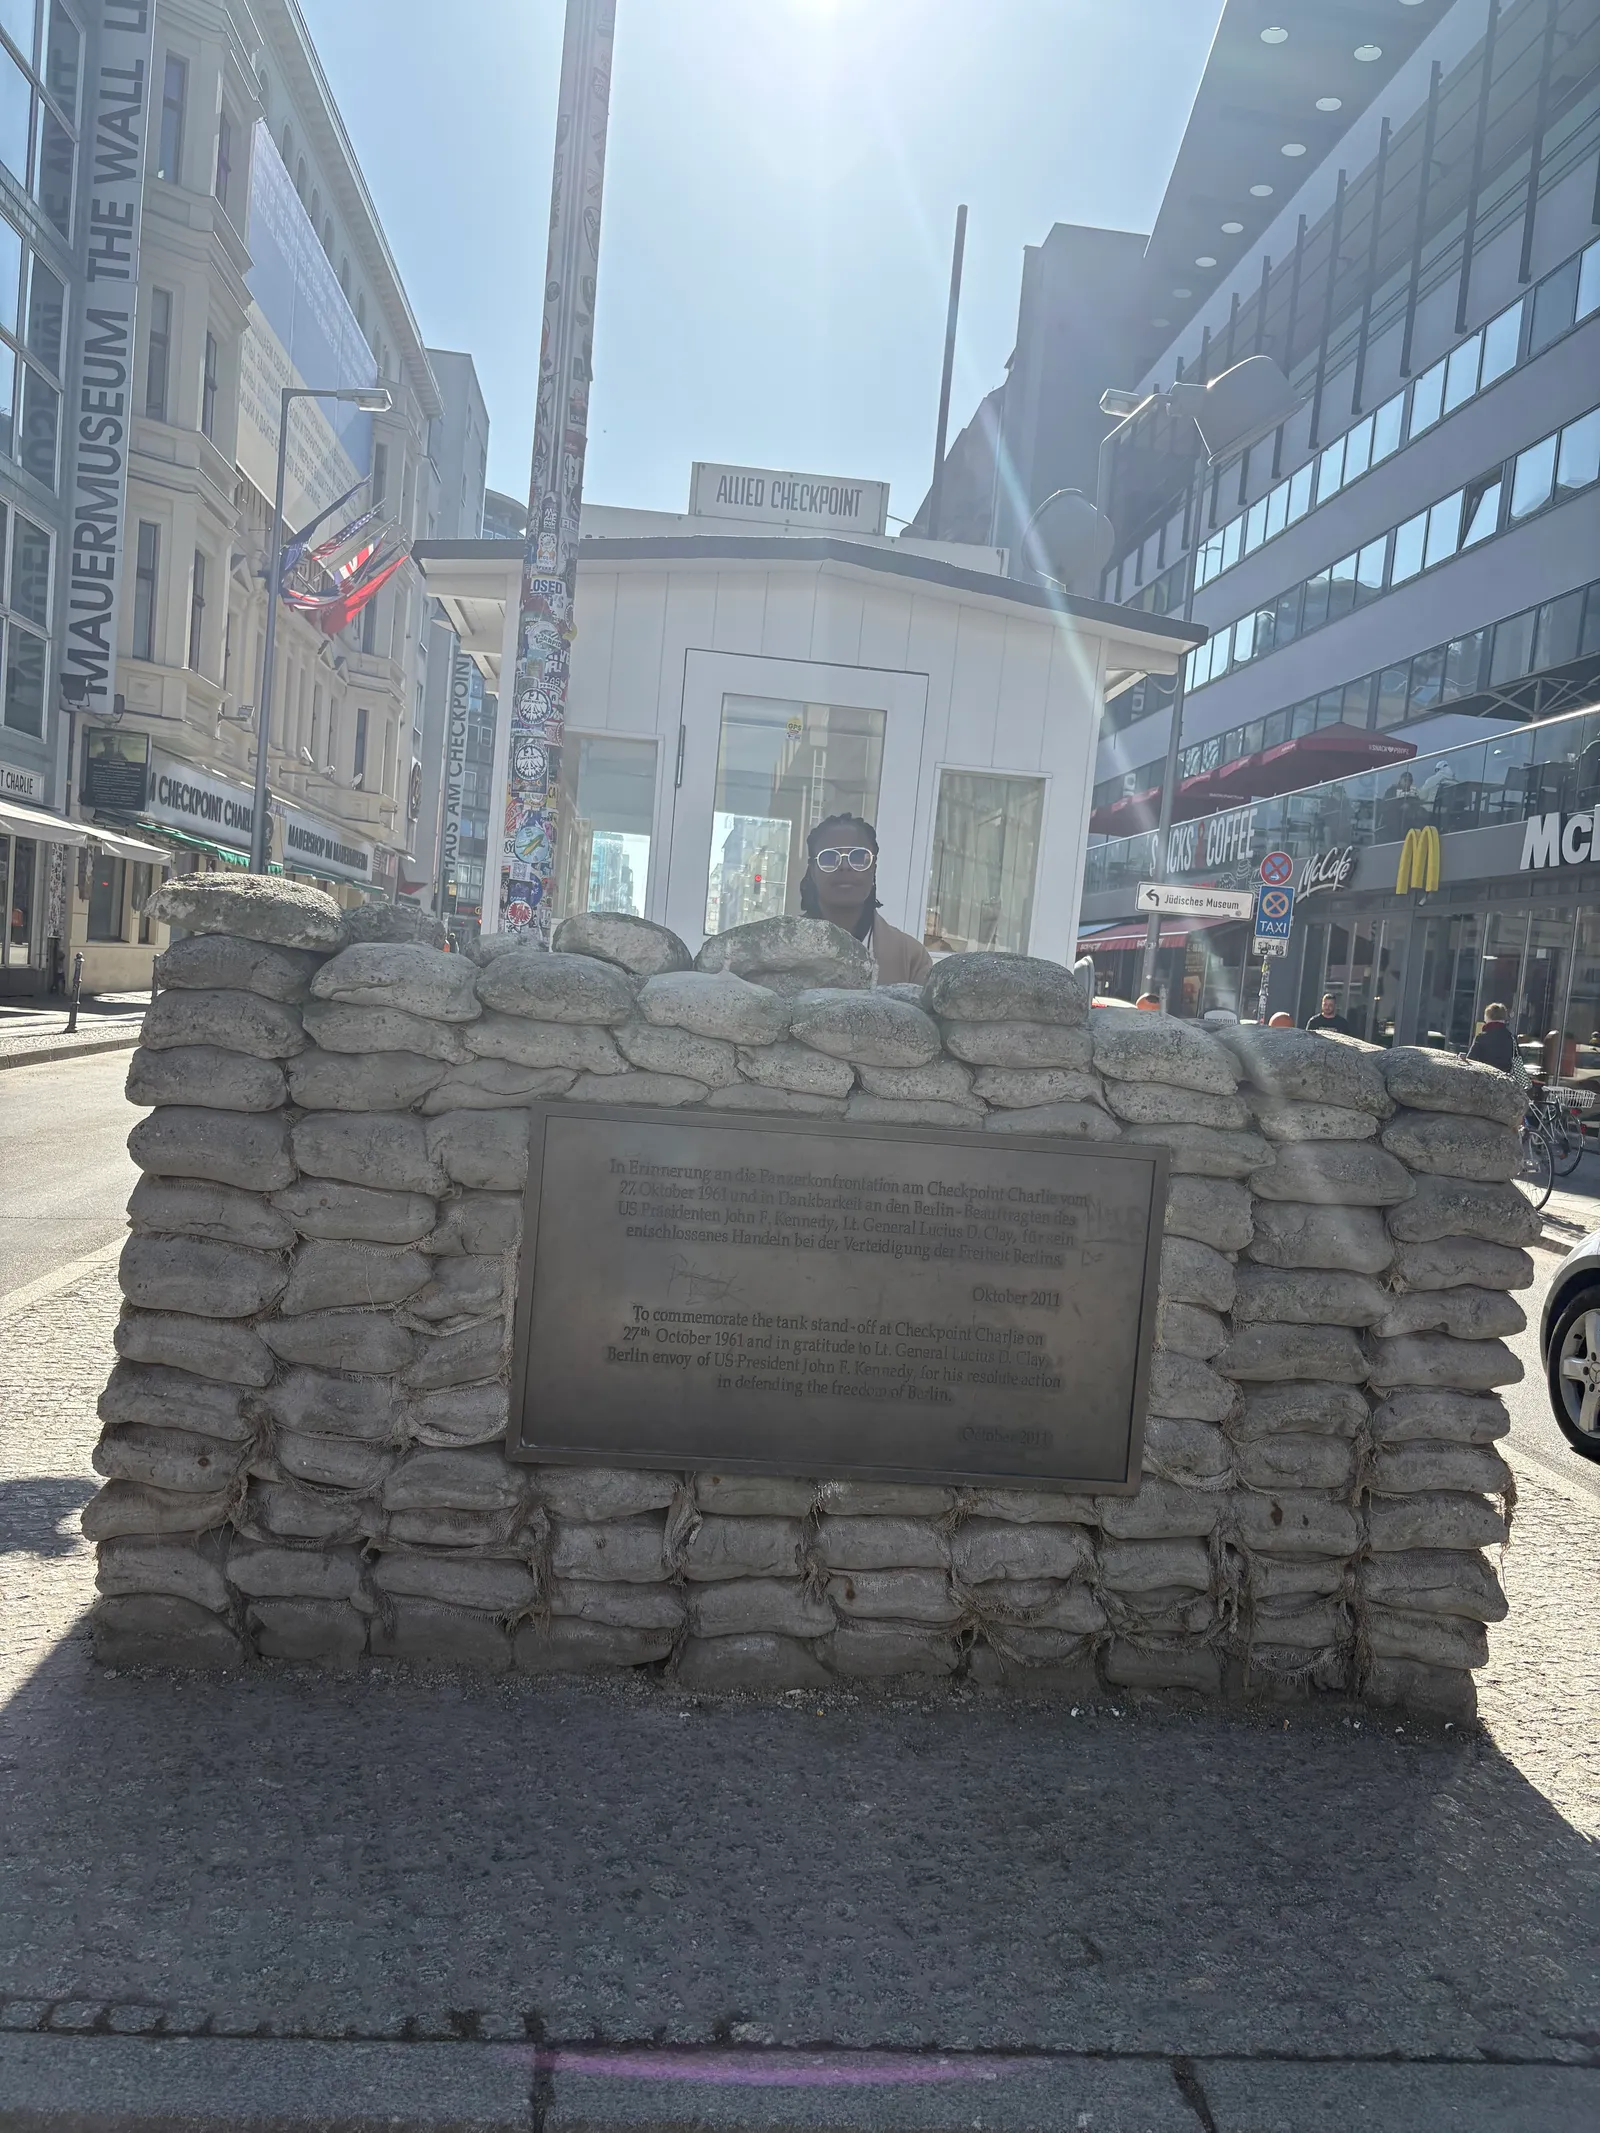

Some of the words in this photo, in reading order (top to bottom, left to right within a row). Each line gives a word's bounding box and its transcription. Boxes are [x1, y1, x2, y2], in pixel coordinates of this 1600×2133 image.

[94, 59, 144, 184] WALL
[88, 199, 134, 281] THE
[66, 309, 128, 695] MAUERMUSEUM
[716, 475, 765, 507] ALLIED
[770, 480, 862, 517] CHECKPOINT
[530, 580, 562, 595] OSED
[6, 771, 33, 795] CHARLIE
[158, 775, 223, 823] CHECKPOINT
[448, 784, 462, 816] AM
[444, 822, 459, 873] HAUS
[1206, 808, 1258, 867] COFFEE
[1298, 846, 1354, 896] McCafé
[1164, 894, 1204, 907] Jüdisches
[1206, 899, 1239, 910] Museum
[1260, 920, 1287, 934] TAXI
[609, 1158, 625, 1174] In
[629, 1160, 712, 1184] Erinnerung
[714, 1170, 732, 1182] an
[735, 1167, 756, 1183] die
[759, 1168, 899, 1195] Panzerkonfrontation
[902, 1184, 924, 1195] am
[927, 1181, 1002, 1202] Checkpoint
[1007, 1187, 1059, 1203] Charlie
[1060, 1193, 1088, 1207] vom
[639, 1181, 694, 1199] Oktober
[699, 1186, 728, 1200] 1961
[730, 1188, 757, 1203] und
[761, 1191, 774, 1204] in
[779, 1191, 862, 1211] Dankbarkeit
[865, 1200, 882, 1212] an
[885, 1197, 910, 1214] den
[1055, 1208, 1076, 1225] des
[618, 1201, 637, 1216] US
[641, 1202, 721, 1222] Präsidenten
[724, 1208, 755, 1226] John
[759, 1210, 772, 1226] F.
[774, 1212, 839, 1233] Kennedy,
[843, 1216, 860, 1232] Lt.
[863, 1218, 916, 1237] General
[920, 1222, 963, 1238] Lucius
[967, 1225, 981, 1240] D.
[984, 1228, 1017, 1246] Clay,
[1022, 1229, 1045, 1245] für
[1048, 1233, 1075, 1247] sein
[626, 1225, 728, 1243] entschlossenes
[731, 1229, 790, 1247] Handeln
[794, 1233, 815, 1248] bei
[817, 1235, 840, 1250] der
[843, 1236, 930, 1259] Verteidigung
[934, 1241, 954, 1258] der
[959, 1244, 1010, 1262] Freiheit
[972, 1287, 1028, 1306] Oktober
[1030, 1291, 1060, 1307] 2011
[623, 1326, 650, 1341] 27th
[656, 1328, 712, 1346] October
[715, 1331, 744, 1347] 1961
[747, 1333, 772, 1349] and
[776, 1335, 790, 1350] in
[793, 1338, 855, 1356] gratitude
[858, 1342, 871, 1356] to
[874, 1341, 892, 1357] Lt.
[895, 1342, 948, 1360] General
[952, 1346, 995, 1364] Lucius
[998, 1349, 1012, 1365] D.
[633, 1305, 650, 1322] To
[653, 1308, 748, 1327] commemorate
[752, 1312, 773, 1328] the
[776, 1315, 808, 1331] tank
[879, 1322, 892, 1336] at
[895, 1321, 973, 1343] Checkpoint
[976, 1327, 1024, 1345] Charlie
[1027, 1334, 1044, 1346] on
[607, 1346, 649, 1363] Berlin
[652, 1352, 691, 1370] envoy
[697, 1351, 711, 1367] of
[714, 1352, 734, 1368] US
[736, 1355, 799, 1373] President
[801, 1357, 836, 1375] John
[839, 1359, 851, 1375] F.
[919, 1364, 940, 1380] for
[943, 1366, 964, 1382] his
[967, 1370, 1019, 1387] resolute
[1020, 1374, 1061, 1389] action
[717, 1374, 731, 1388] in
[735, 1375, 803, 1397] defending
[807, 1378, 828, 1394] the
[831, 1380, 887, 1398] freedom
[890, 1384, 906, 1399] of
